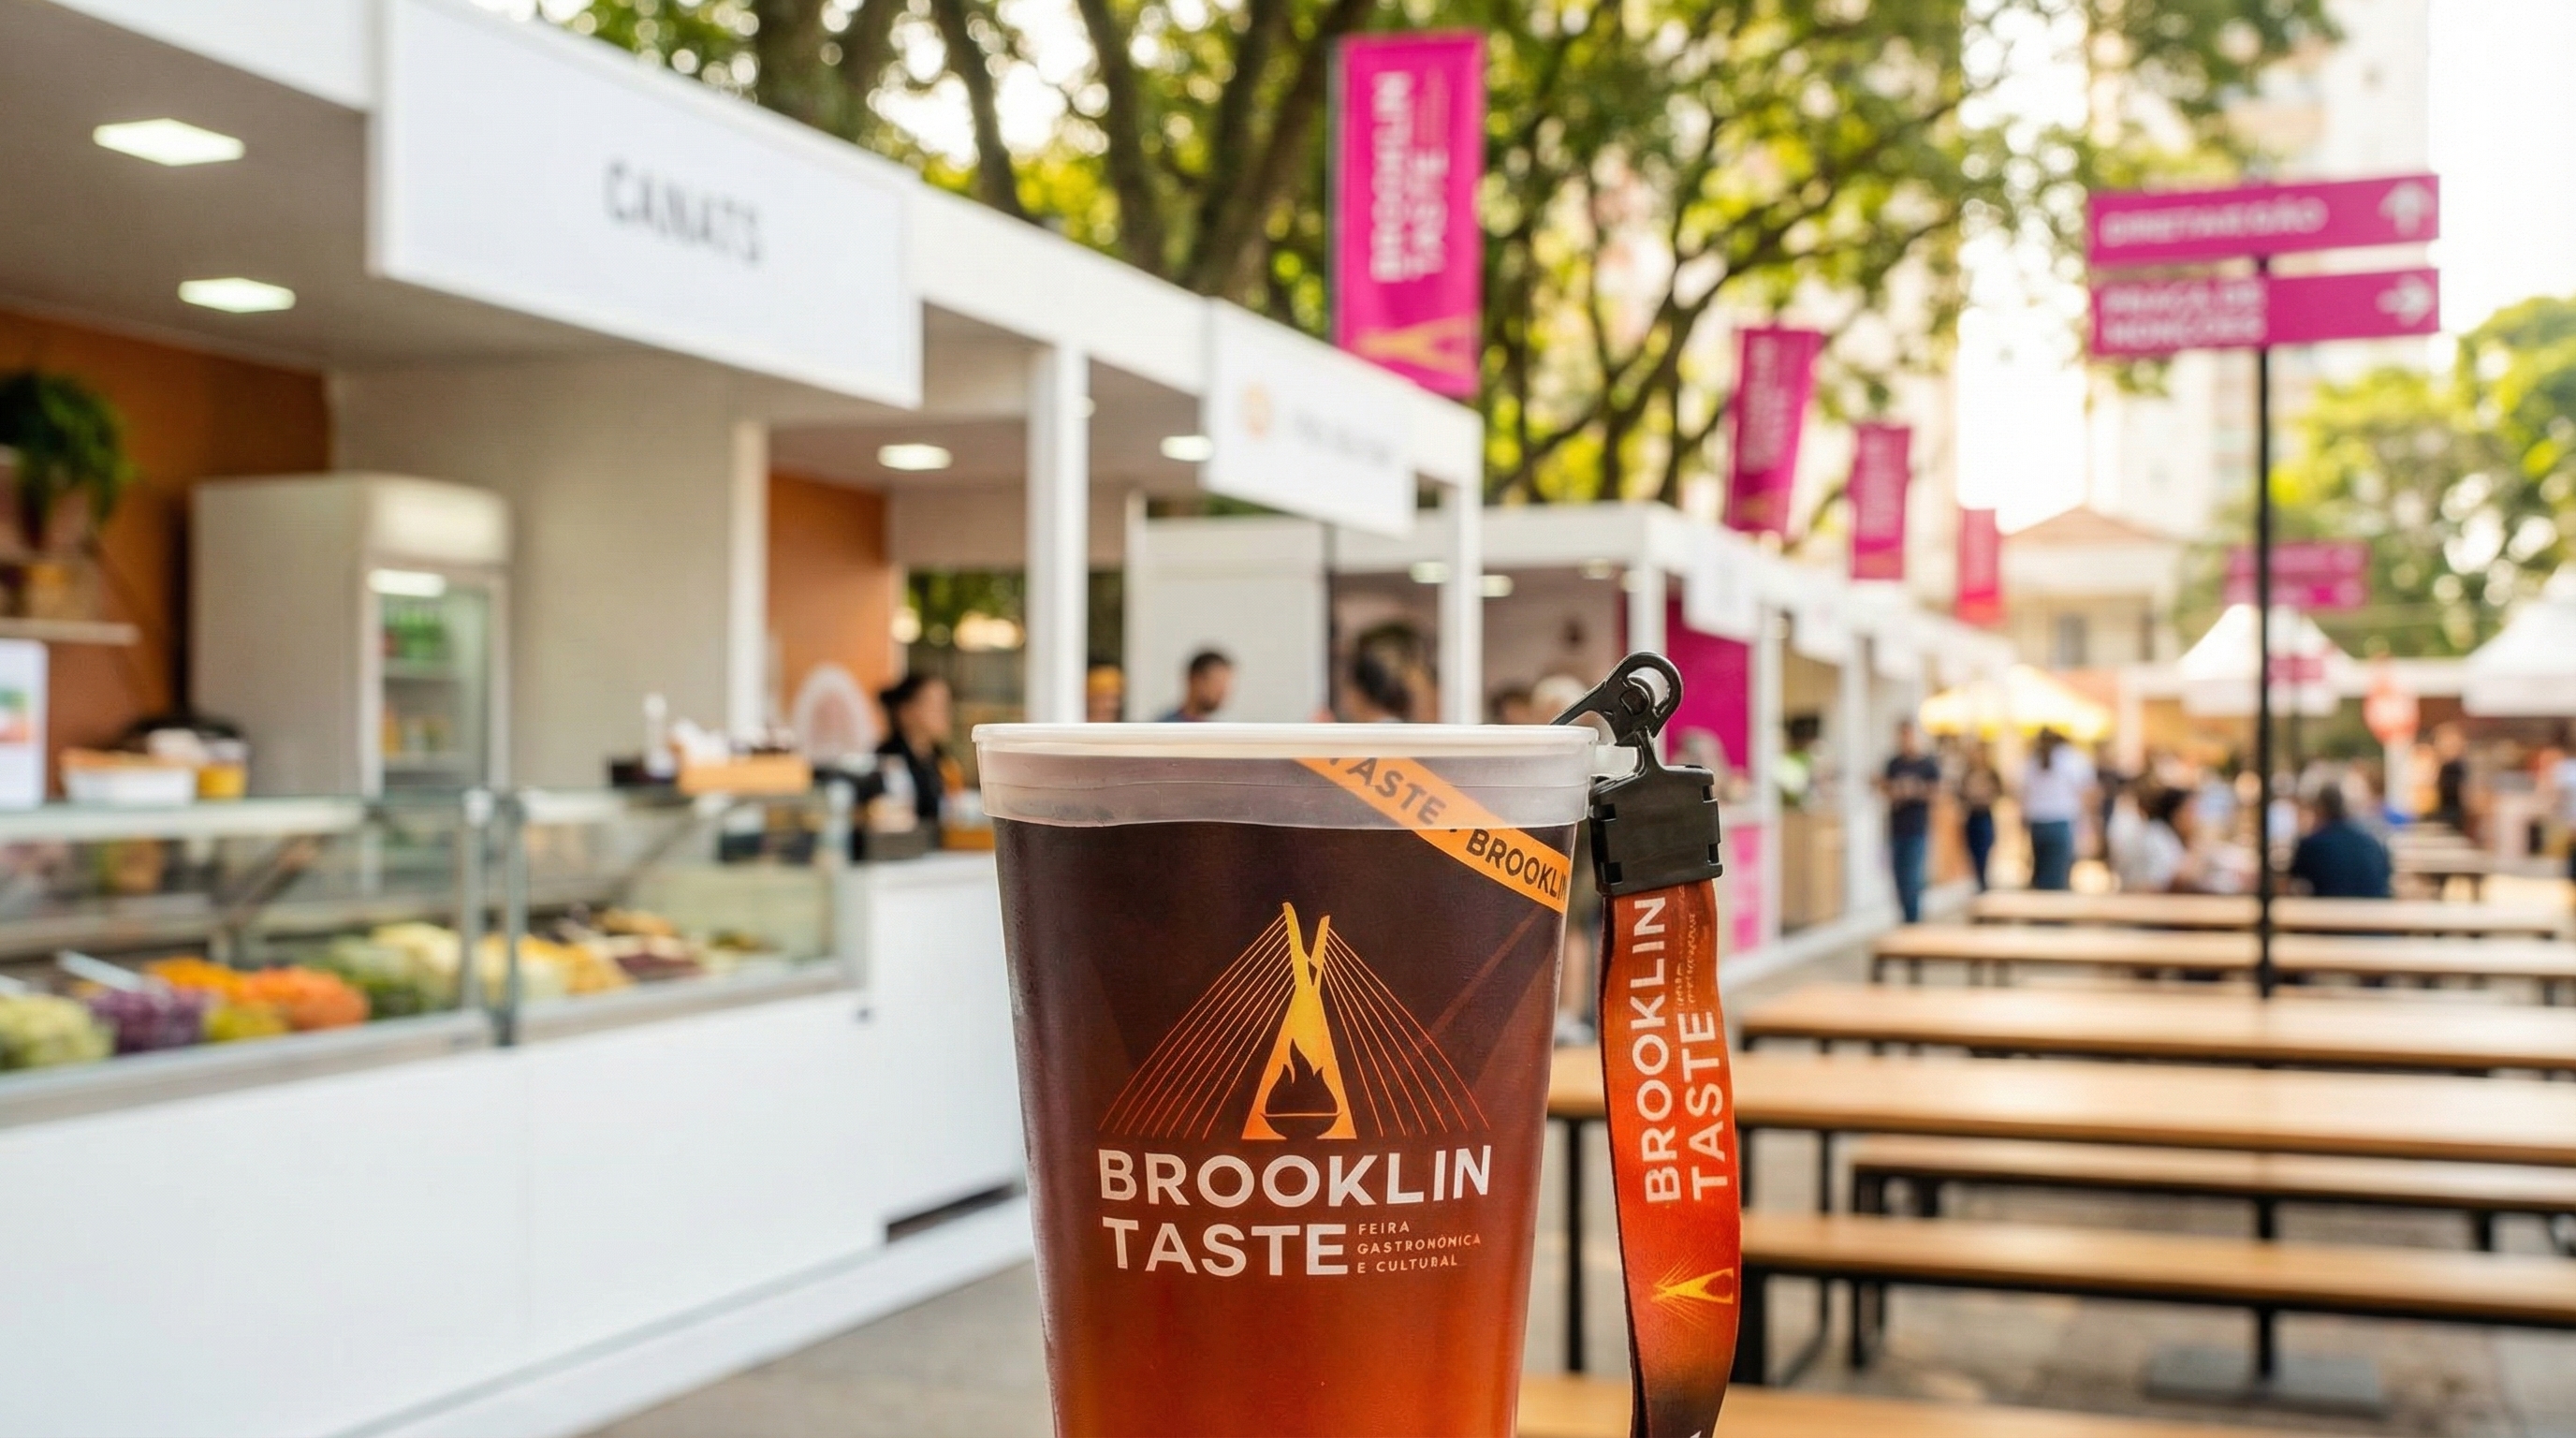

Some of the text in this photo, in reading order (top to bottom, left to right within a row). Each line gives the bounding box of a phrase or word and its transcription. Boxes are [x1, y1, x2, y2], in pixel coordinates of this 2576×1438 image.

[1329, 757, 1447, 826] ASTE
[1630, 897, 1682, 1203] BROOKLIN
[1677, 1010, 1728, 1201] TASTE
[1098, 1145, 1492, 1208] BROOKLIN
[1103, 1216, 1349, 1277] TASTE
[1358, 1221, 1410, 1235] FEIRA
[1357, 1262, 1366, 1273] E
